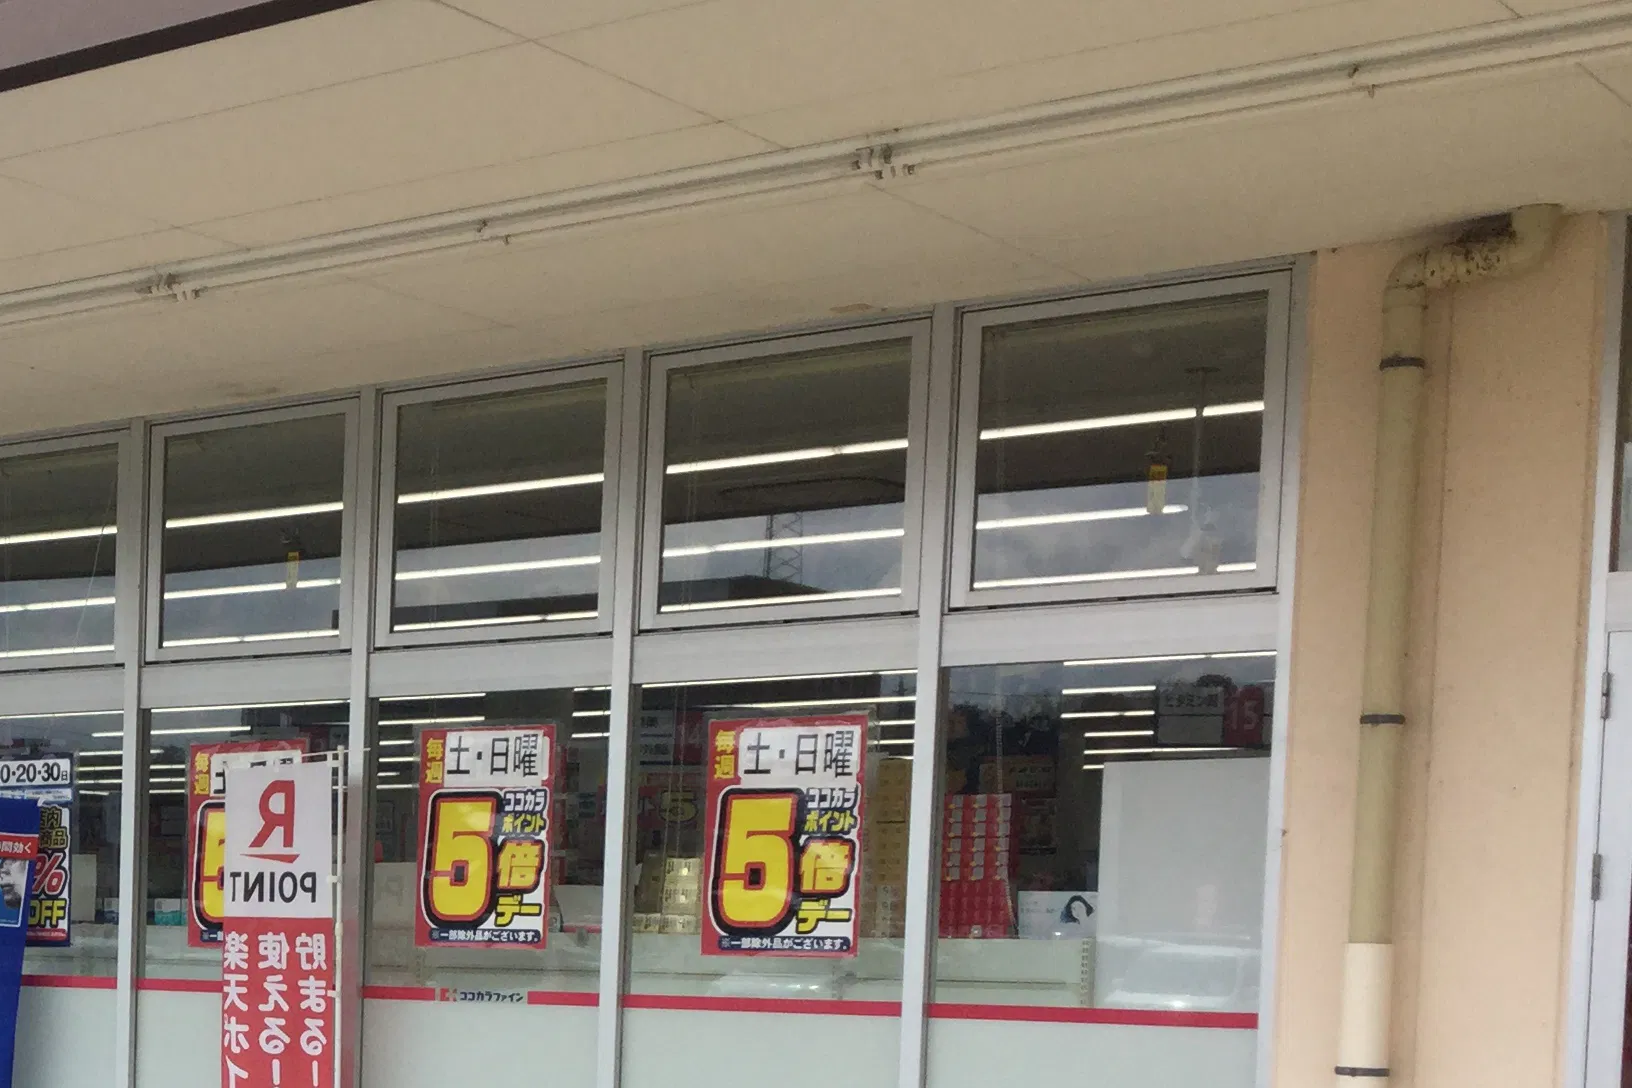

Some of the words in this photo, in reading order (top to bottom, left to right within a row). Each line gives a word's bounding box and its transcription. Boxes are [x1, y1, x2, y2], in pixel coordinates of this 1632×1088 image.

[1229, 701, 1259, 730] 15
[425, 738, 444, 784] 毎週
[447, 734, 538, 777] 土・日曜
[714, 730, 736, 779] 毎週
[744, 731, 855, 778] 土・日曜
[194, 752, 210, 795] 毎週
[505, 791, 545, 812] ココカラ
[807, 788, 855, 809] ココカラ
[502, 814, 544, 833] ポイント
[804, 810, 855, 832] ポイント
[430, 797, 494, 920] 5
[498, 843, 541, 890] 倍
[721, 795, 794, 926] 5
[801, 841, 851, 892] 倍
[460, 991, 524, 1002] ココカラファイン
